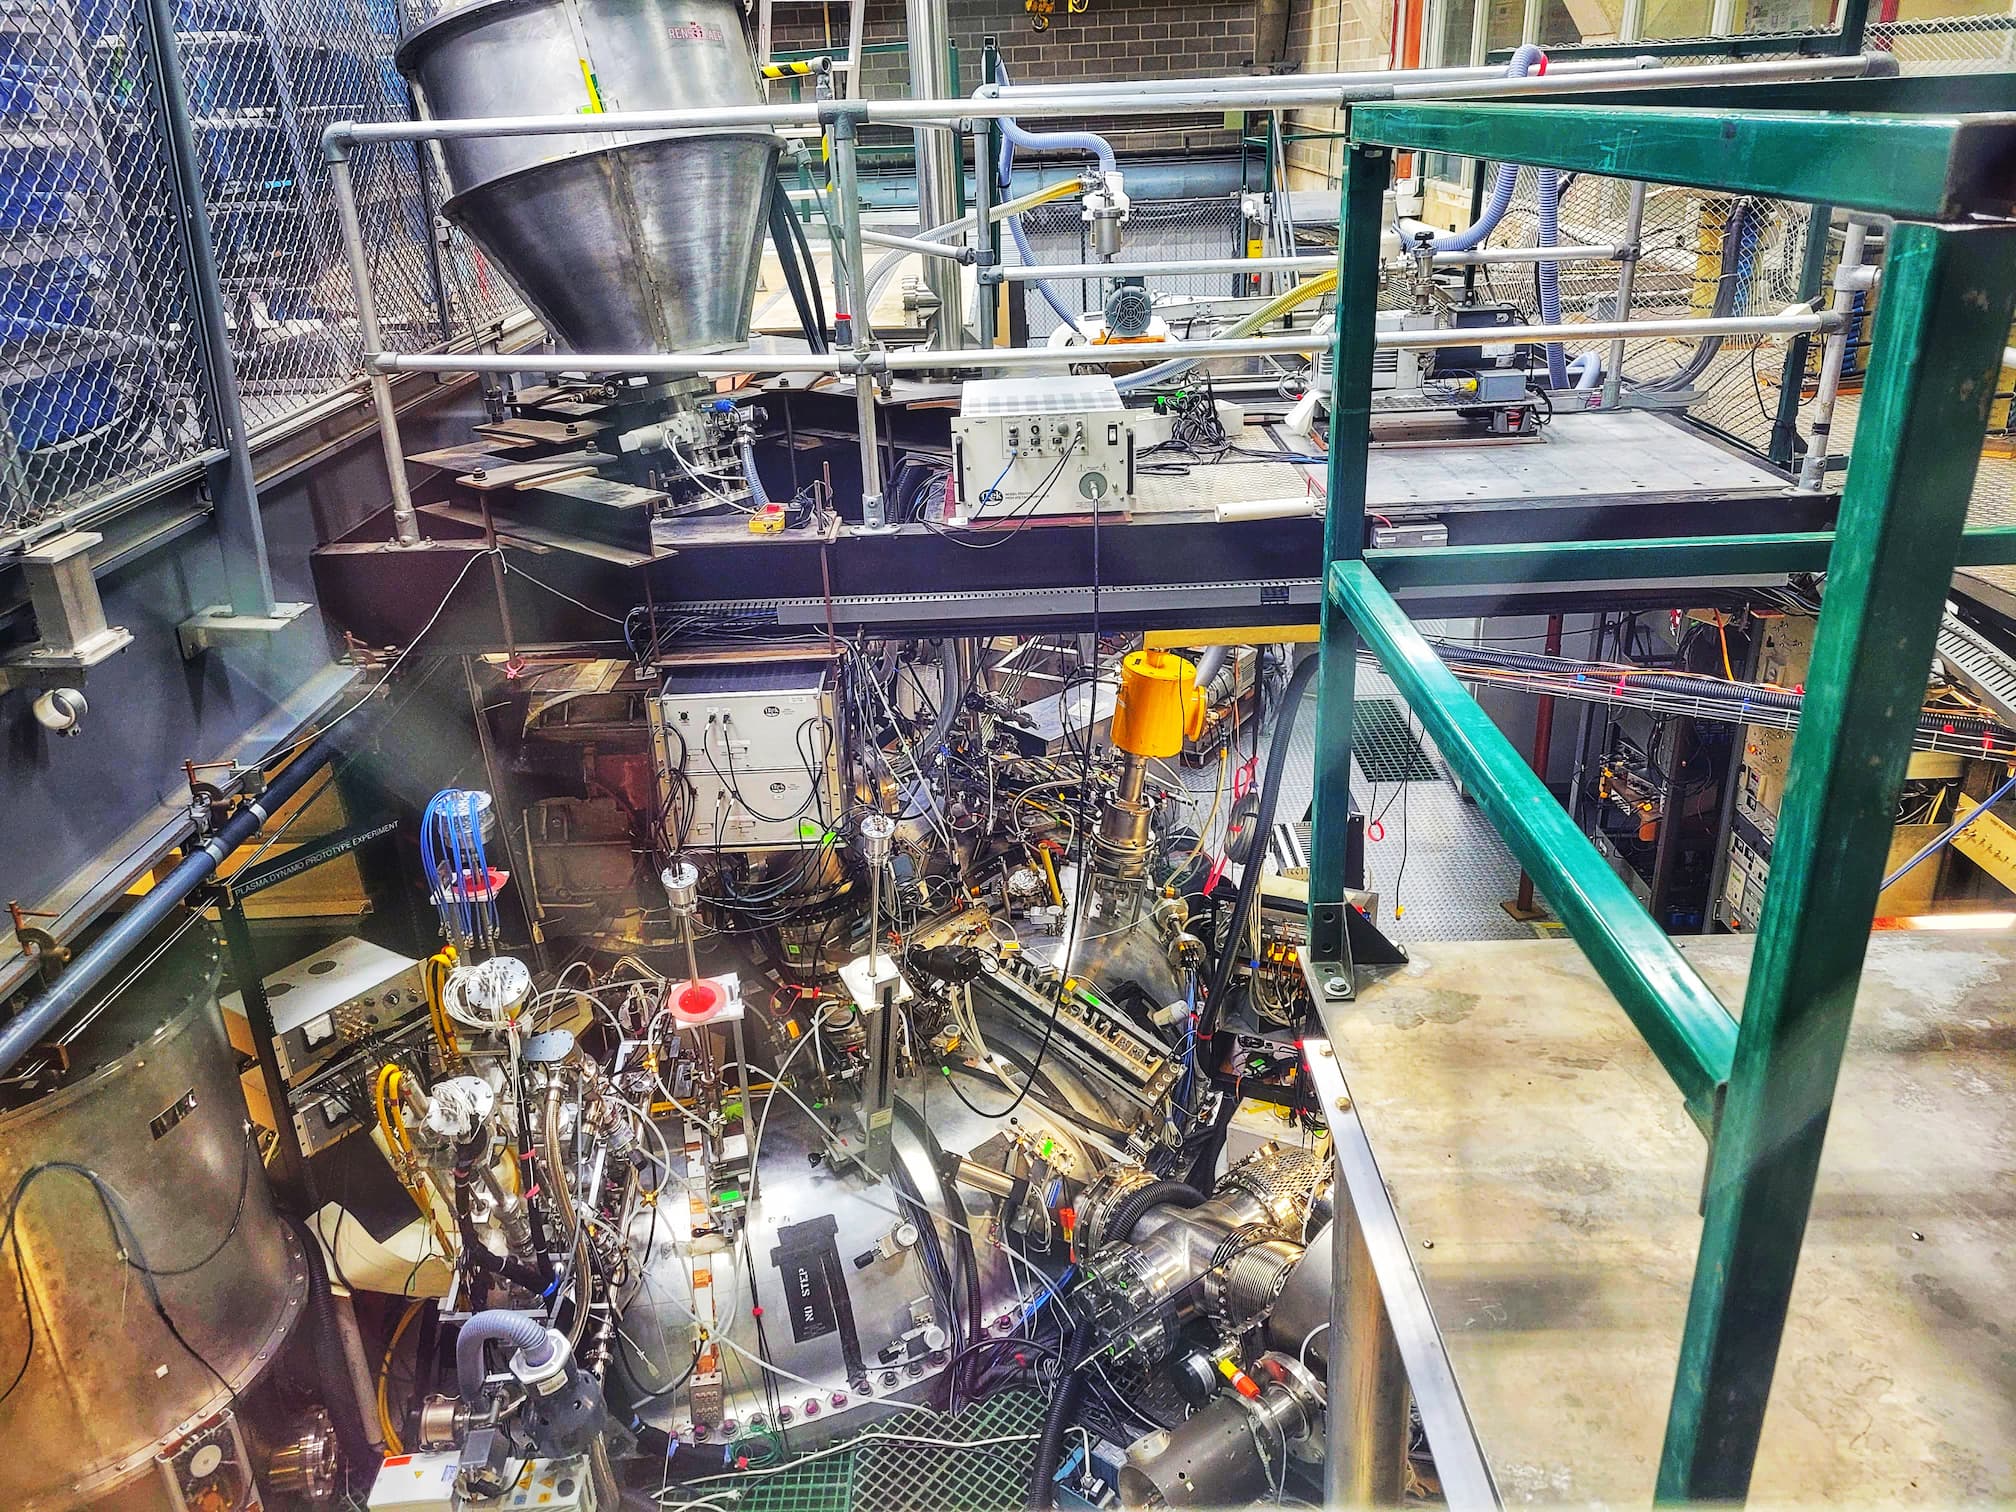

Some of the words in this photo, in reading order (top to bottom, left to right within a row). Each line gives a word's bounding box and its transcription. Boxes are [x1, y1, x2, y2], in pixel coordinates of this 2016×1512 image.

[234, 875, 269, 898] PLASMA
[269, 862, 305, 882] DYNAMO
[305, 841, 352, 866] PROTOTYPE
[352, 819, 399, 847] EXPERIMENT
[798, 1268, 811, 1297] STEP
[803, 1305, 814, 1322] NO
